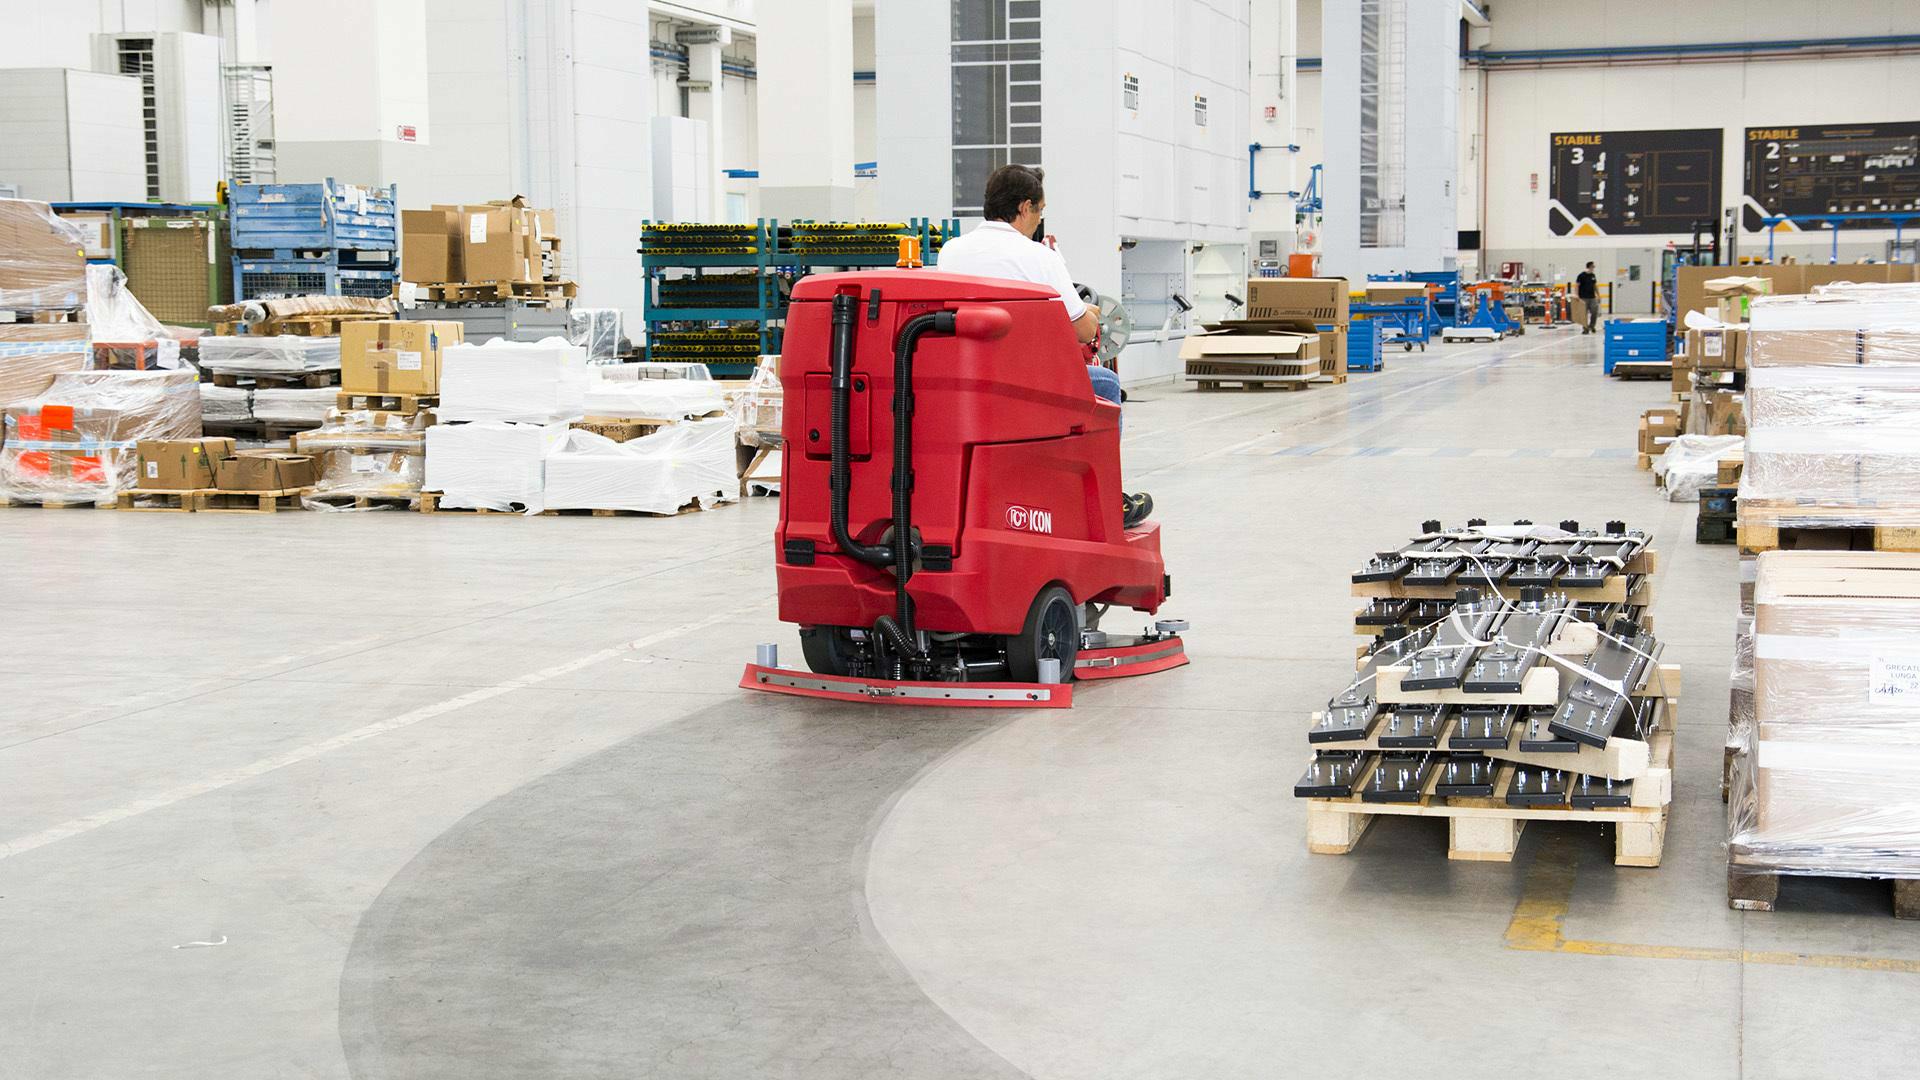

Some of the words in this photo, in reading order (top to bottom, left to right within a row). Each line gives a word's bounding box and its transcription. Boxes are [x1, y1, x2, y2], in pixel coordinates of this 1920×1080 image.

[1554, 135, 1602, 146] STABILE
[1748, 129, 1799, 141] STABILE
[1571, 147, 1584, 165] 3
[1766, 142, 1780, 160] 2
[1029, 509, 1052, 534] ICON
